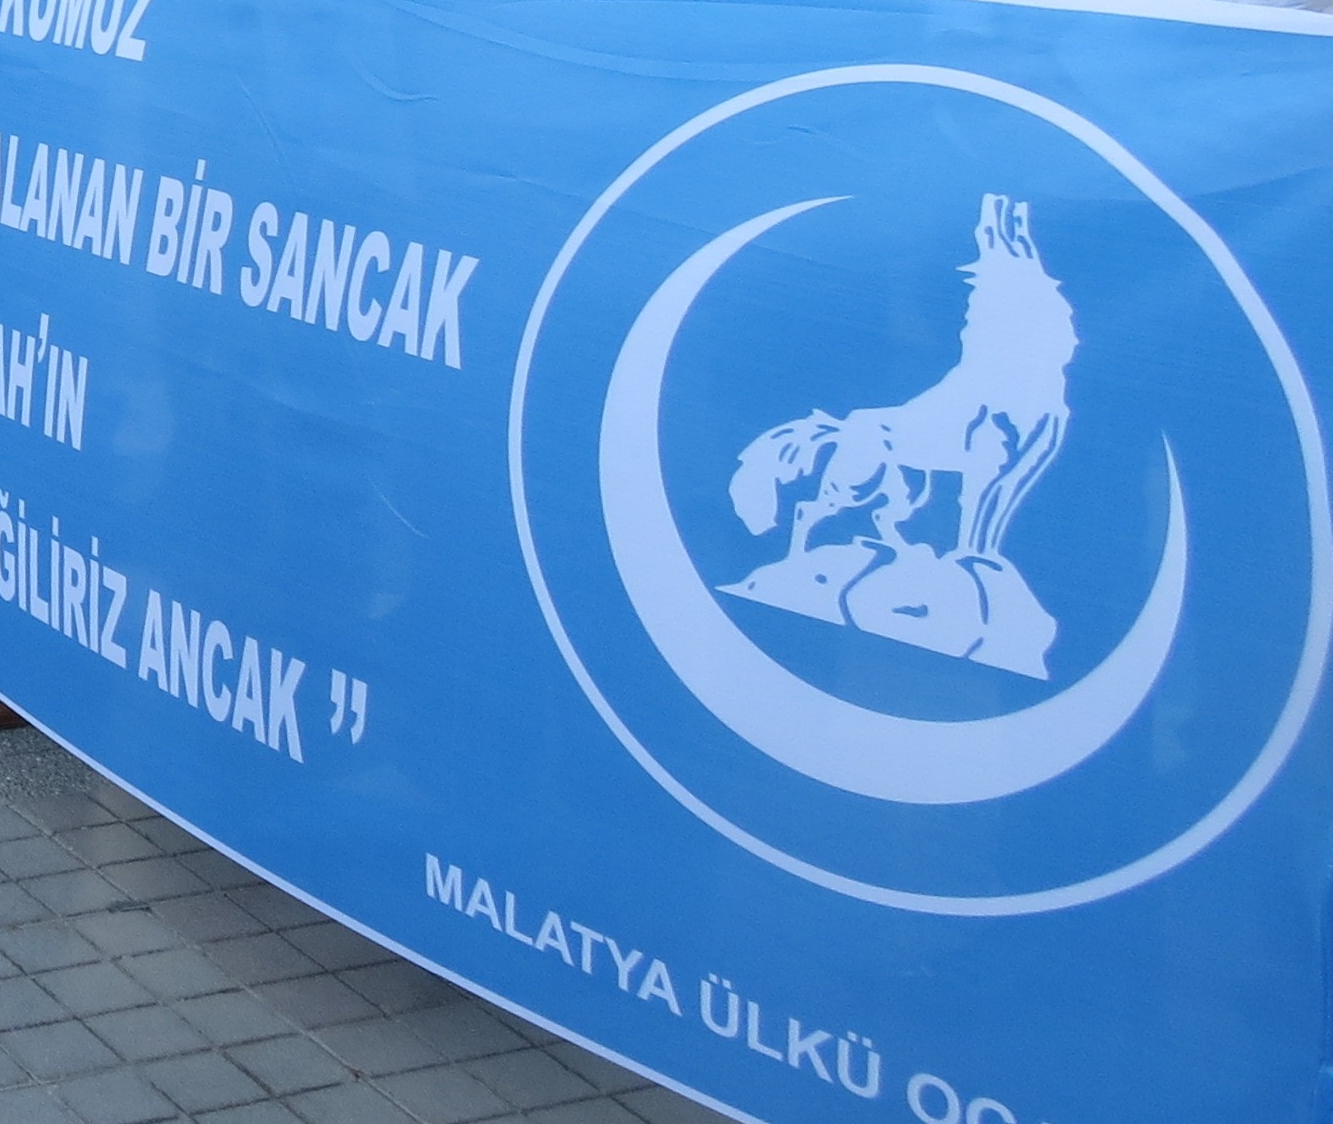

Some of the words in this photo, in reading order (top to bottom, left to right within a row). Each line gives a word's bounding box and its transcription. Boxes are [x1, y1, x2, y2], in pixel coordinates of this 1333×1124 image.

[146, 159, 233, 295] BİR
[239, 201, 480, 370] SANCAK
[137, 589, 306, 765] ANCAK
[425, 852, 682, 1017] MALATYA
[699, 973, 881, 1100] ÜLKÜ
